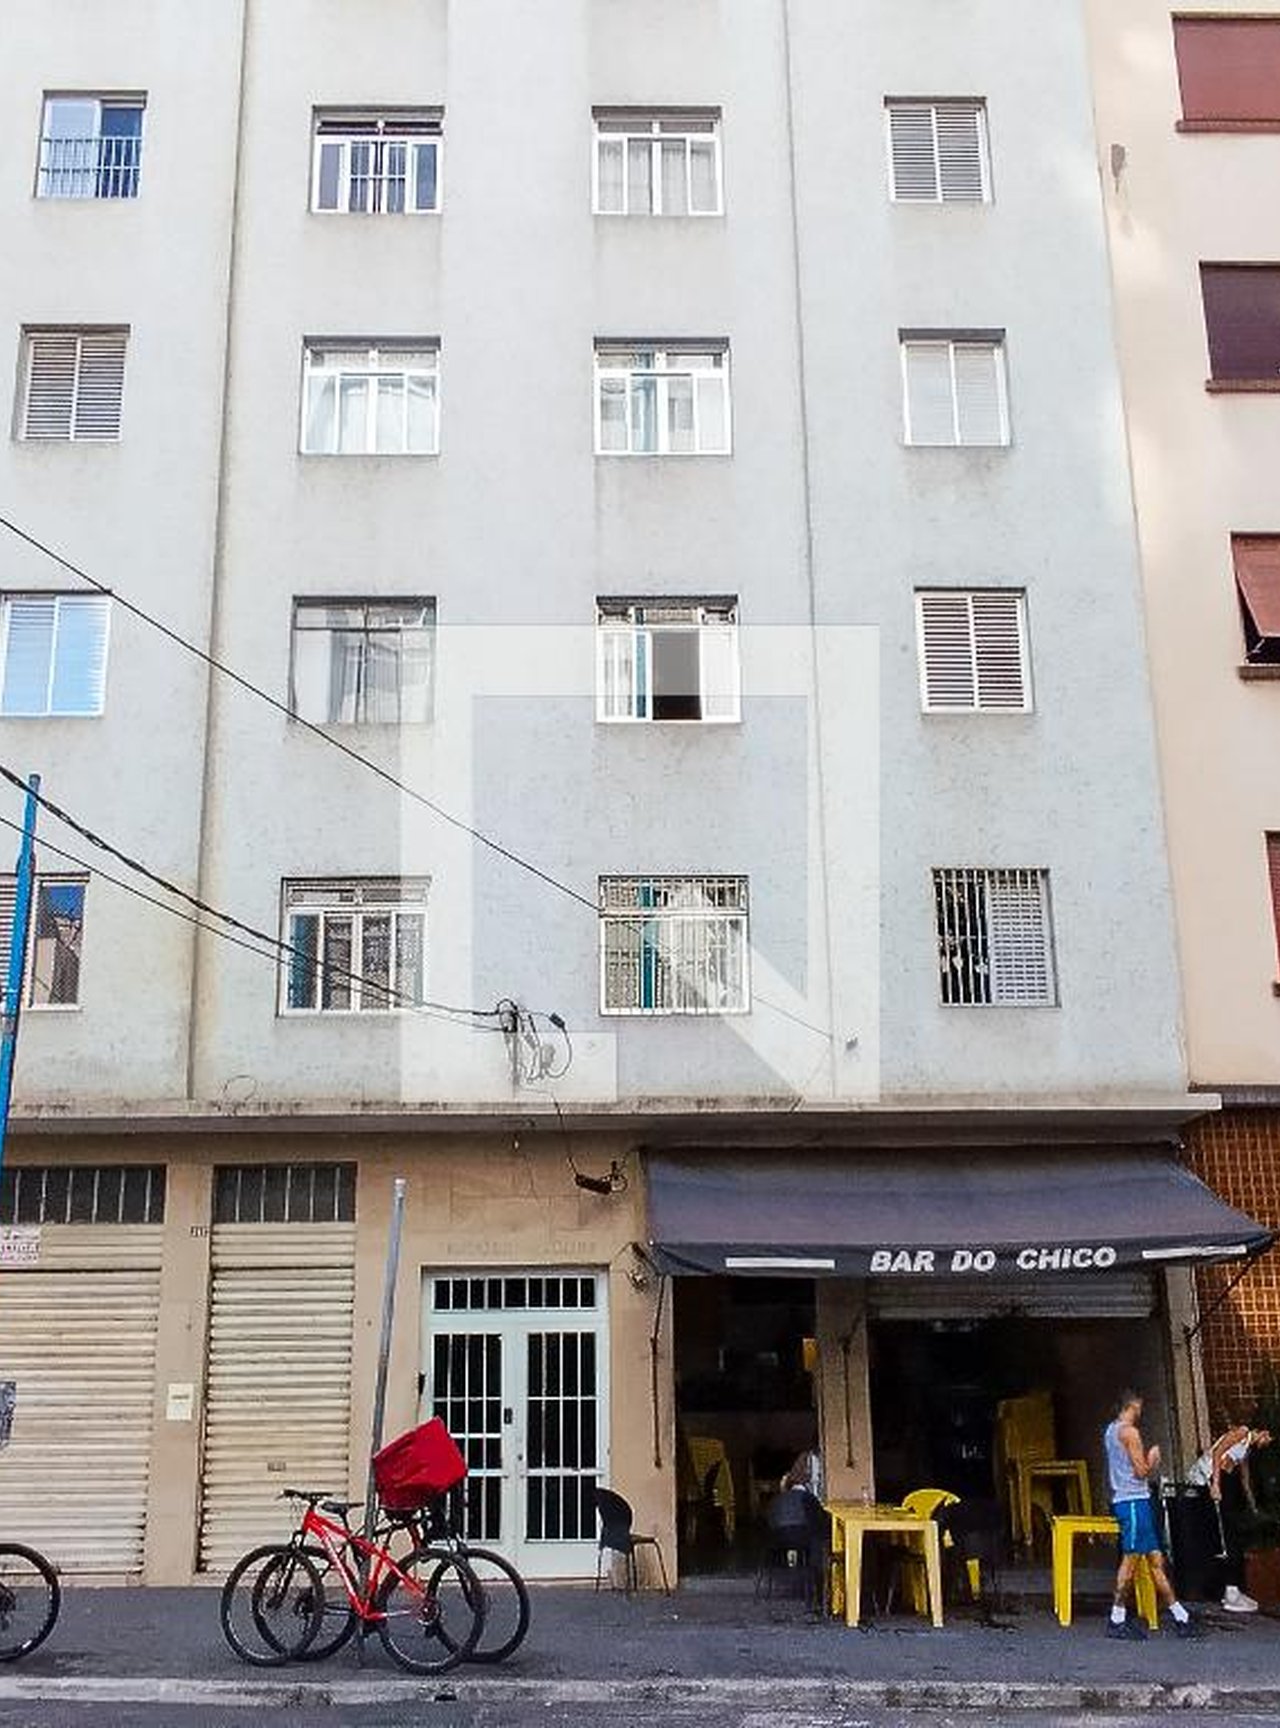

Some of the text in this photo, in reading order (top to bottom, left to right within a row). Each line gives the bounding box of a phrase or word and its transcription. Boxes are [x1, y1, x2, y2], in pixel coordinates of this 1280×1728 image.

[870, 1246, 1116, 1272] BAR DO CHICO
